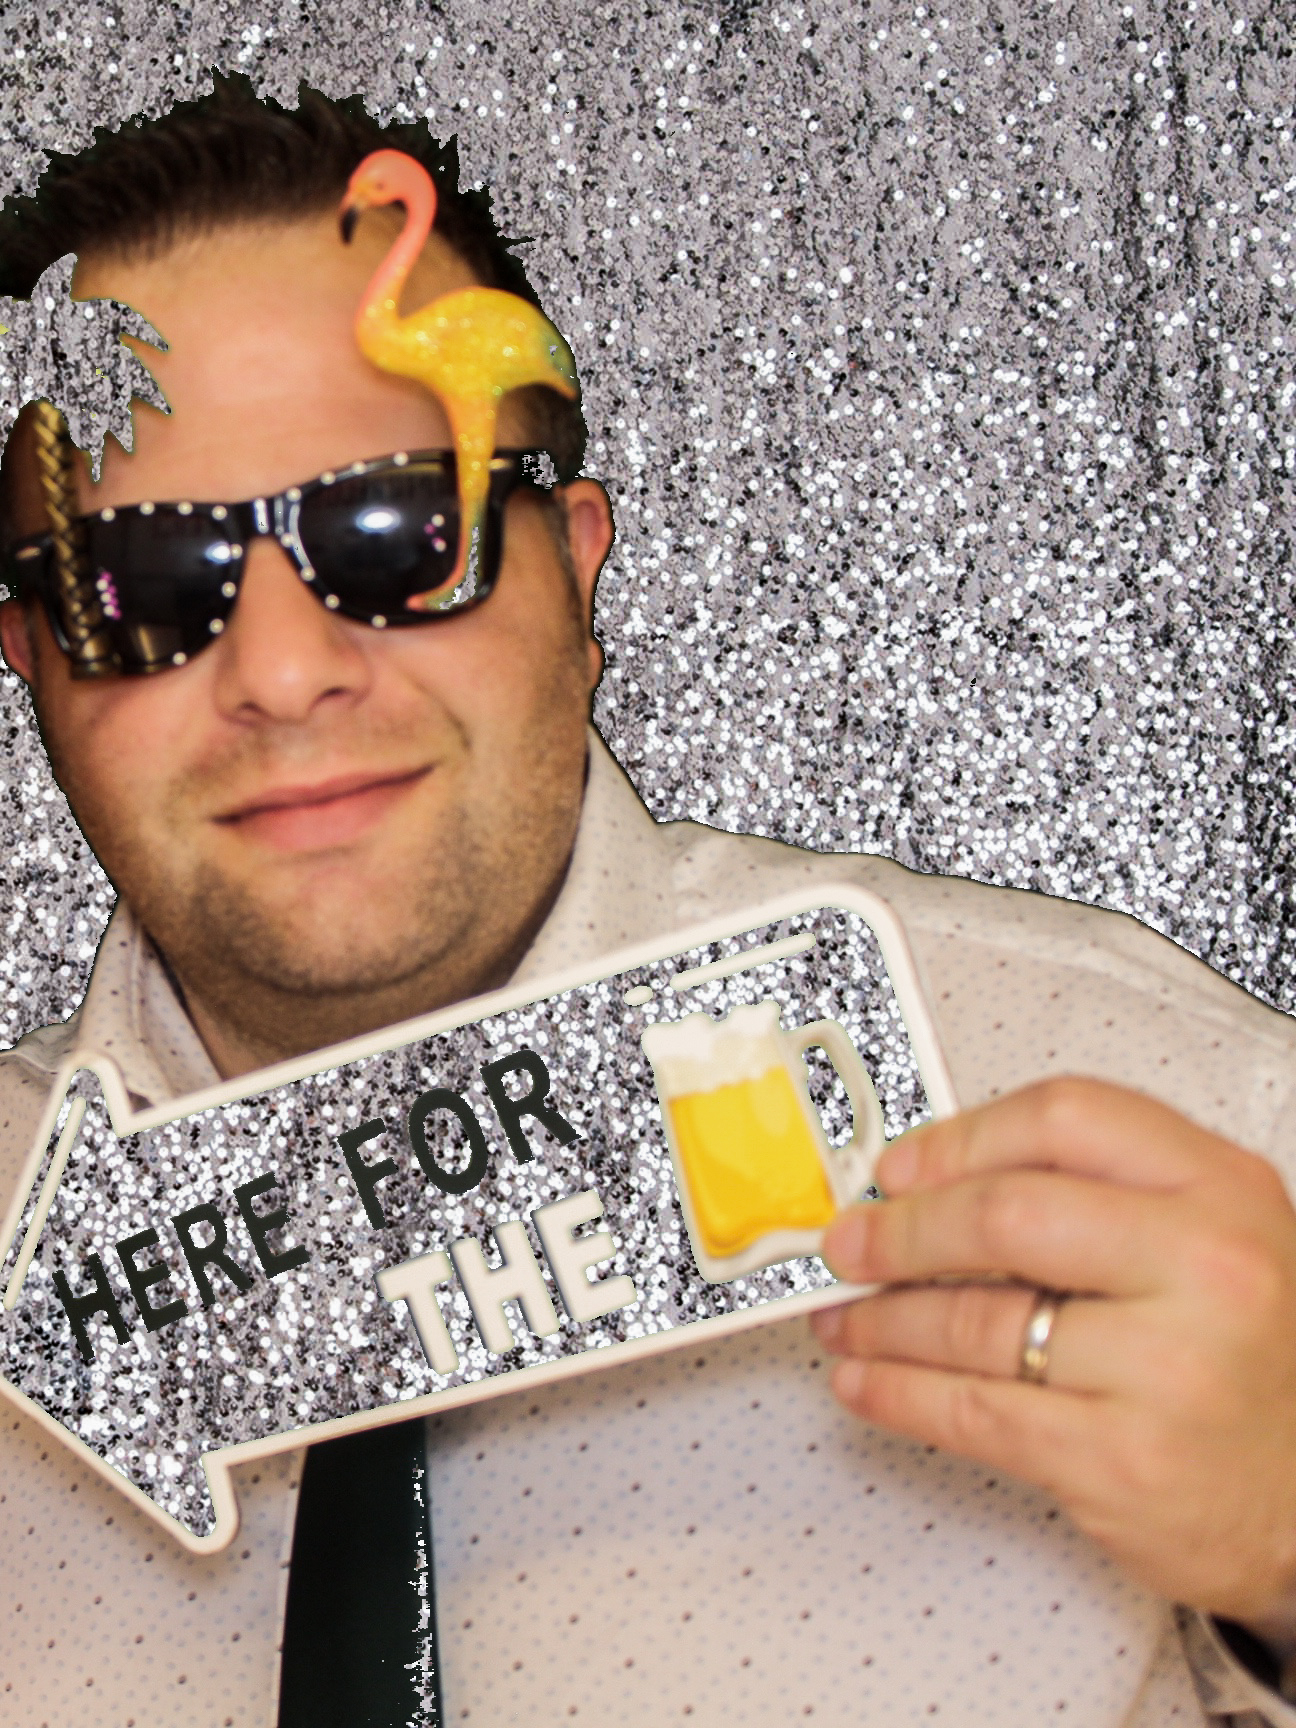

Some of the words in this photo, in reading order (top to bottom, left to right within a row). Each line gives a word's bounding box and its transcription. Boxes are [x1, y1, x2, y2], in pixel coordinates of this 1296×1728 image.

[51, 1171, 310, 1361] HERE
[337, 1048, 582, 1231] FOR
[374, 1190, 637, 1376] THE
